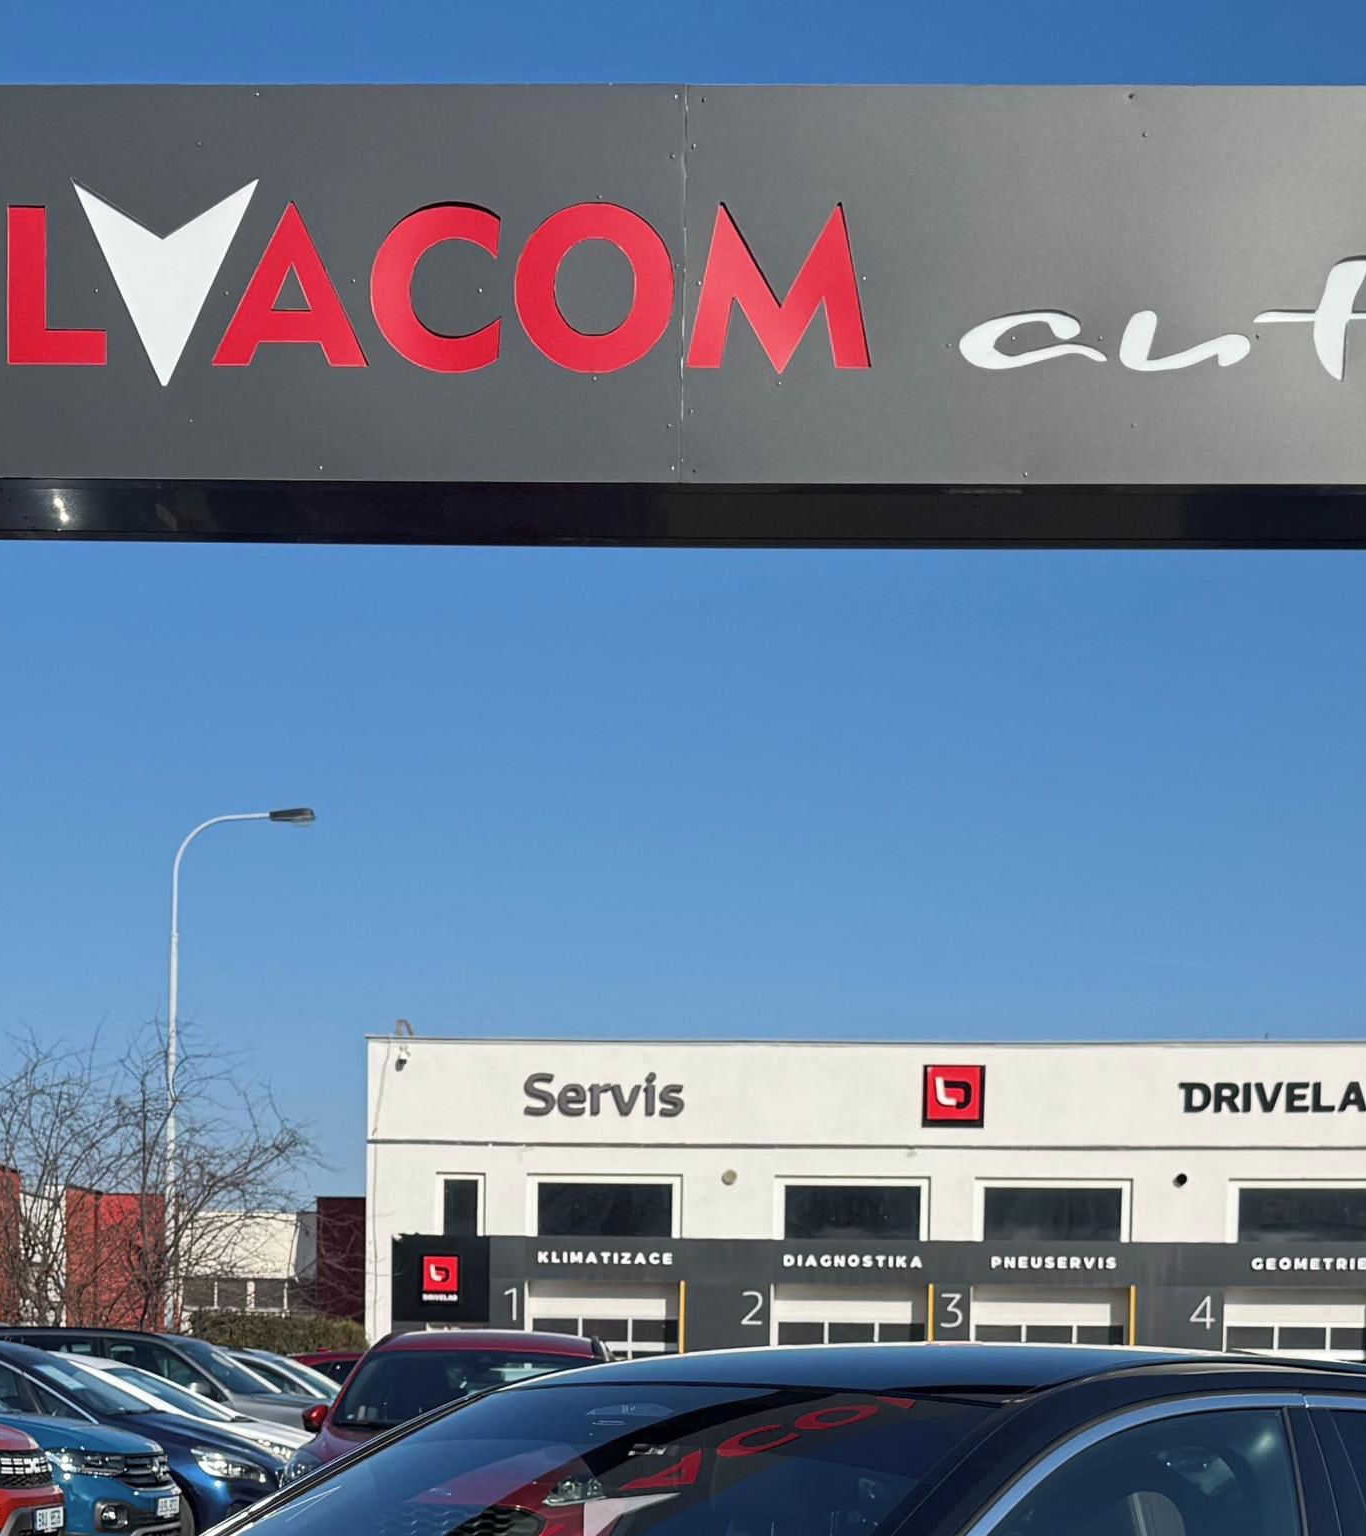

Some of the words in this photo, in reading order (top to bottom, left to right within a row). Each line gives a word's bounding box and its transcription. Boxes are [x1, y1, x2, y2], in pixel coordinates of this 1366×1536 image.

[522, 1071, 686, 1118] Servis
[537, 1251, 674, 1266] KLIMATIZACE
[783, 1254, 923, 1270] DIAGNOSTIKA
[990, 1256, 1118, 1270] PNEUSERVIS
[503, 1288, 518, 1321] 1
[740, 1291, 764, 1326] 2
[939, 1293, 964, 1328] 3
[1189, 1295, 1217, 1330] 4
